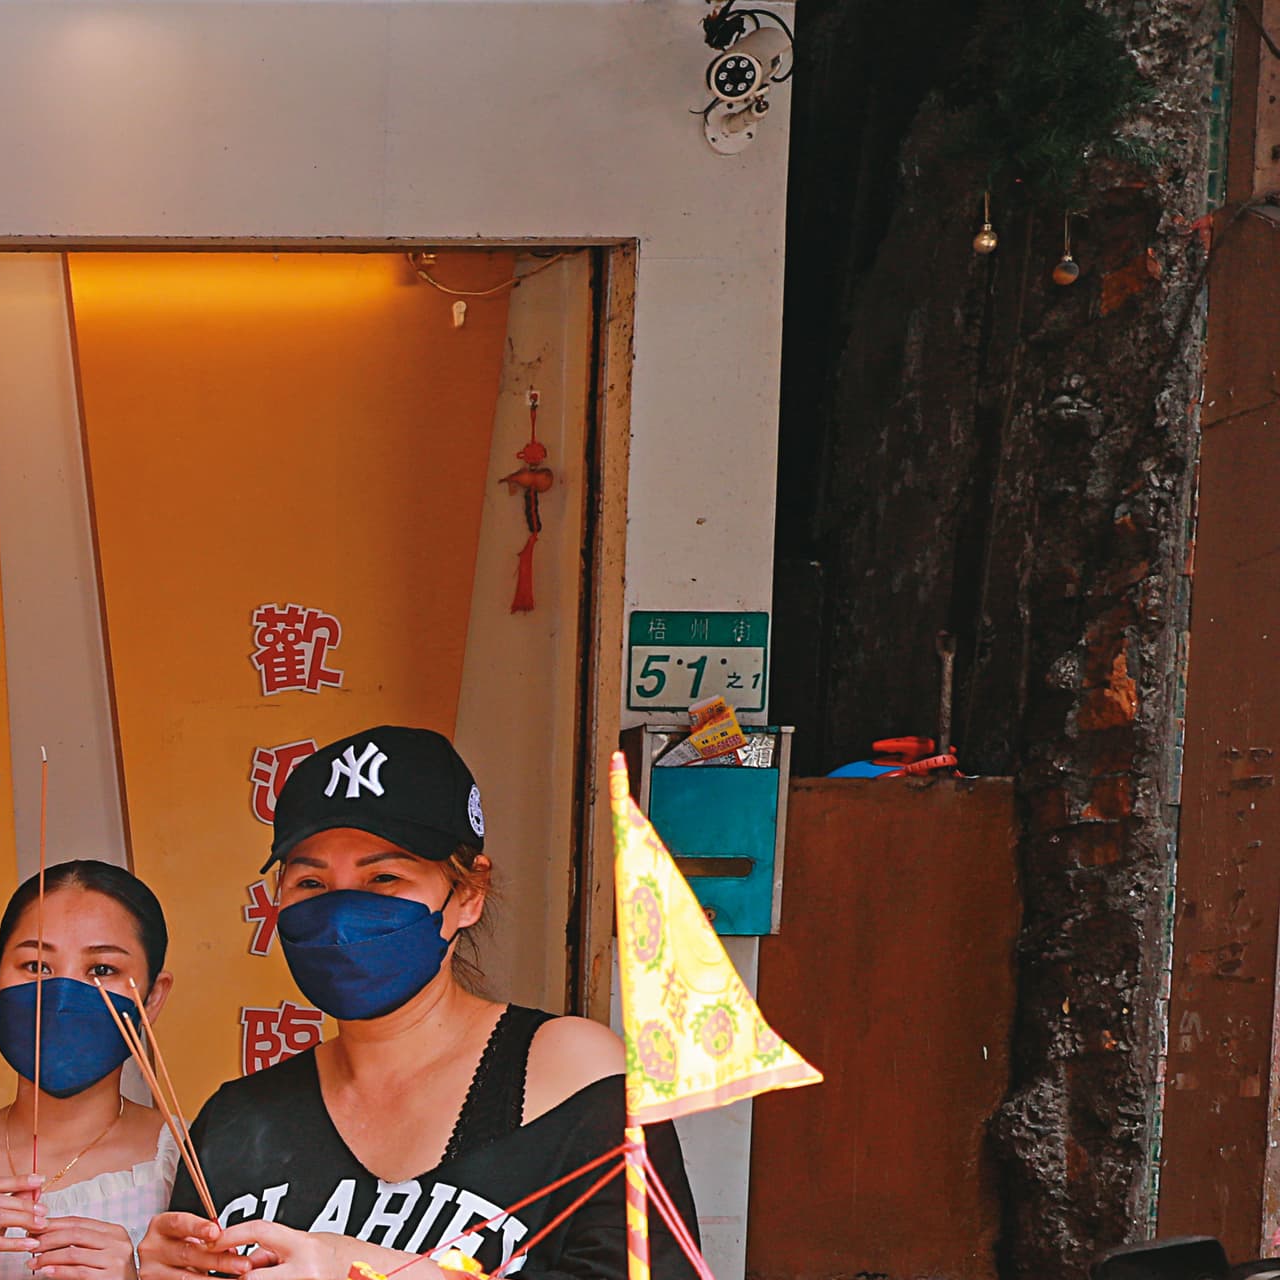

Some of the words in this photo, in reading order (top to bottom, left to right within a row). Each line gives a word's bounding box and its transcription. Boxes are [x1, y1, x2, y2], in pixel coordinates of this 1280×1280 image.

[649, 618, 751, 641] 梧州街
[636, 655, 707, 698] 51
